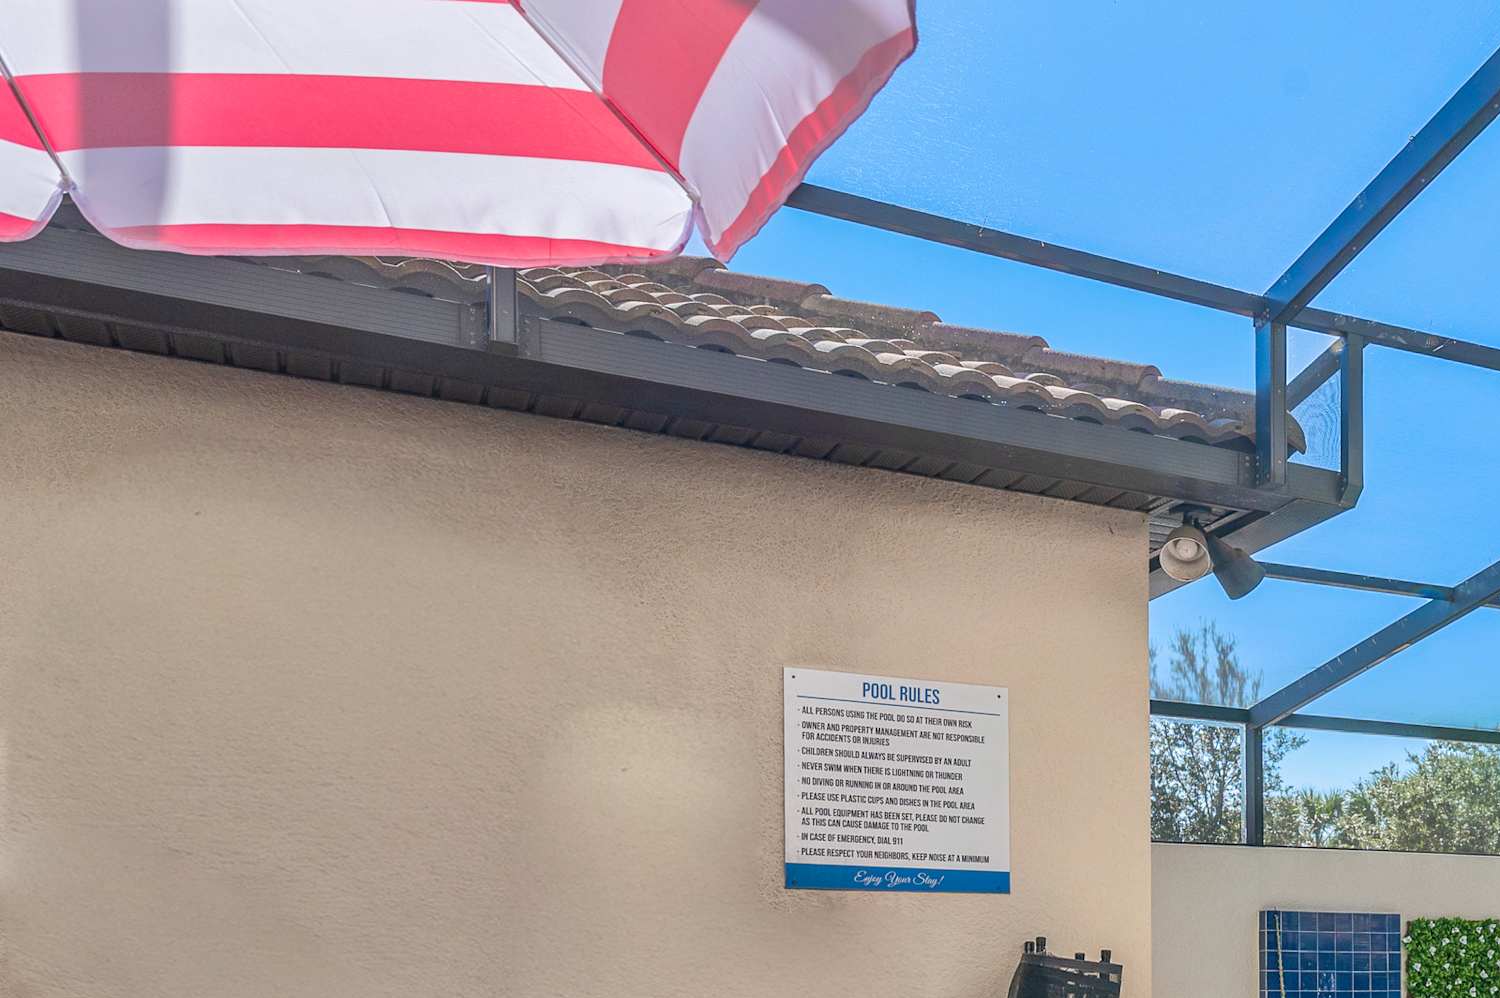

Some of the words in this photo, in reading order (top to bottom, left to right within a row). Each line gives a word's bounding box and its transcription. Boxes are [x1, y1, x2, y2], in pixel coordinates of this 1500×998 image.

[862, 682, 896, 700] POOL
[900, 686, 940, 704] RULES
[802, 706, 813, 715] ALL
[815, 707, 845, 718] PERSONS
[846, 709, 865, 720] USING
[866, 711, 878, 721] THE
[879, 712, 894, 722] POOL
[896, 713, 905, 723] DO
[906, 714, 914, 723] SO
[916, 715, 923, 724] AT
[925, 716, 942, 725] THEIR
[943, 717, 957, 727] OWN
[958, 718, 972, 728] RISK
[802, 721, 825, 731] OWNER
[827, 723, 840, 732] AND
[841, 724, 873, 735] PROPERTY
[875, 726, 917, 738] MANAGEMENT
[919, 730, 931, 739] ARE
[932, 731, 944, 740] NOT
[945, 732, 984, 743] RESPONSIBLE
[802, 731, 814, 741] FOR
[816, 732, 851, 743] ACCIDENTS
[852, 735, 861, 744] OR
[862, 736, 890, 746] INJURIES
[802, 746, 833, 757] CHILDREN
[835, 749, 860, 759] SHOULD
[861, 750, 886, 761] ALWAYS
[887, 752, 895, 761] BE
[896, 753, 933, 764] SUPERVISED
[934, 755, 942, 765] BY
[944, 756, 952, 765] AN
[953, 757, 971, 766] ADULT
[802, 761, 822, 772] NEVER
[824, 763, 842, 773] SWIM
[843, 764, 862, 774] WHEN
[864, 765, 883, 775] THERE
[885, 767, 891, 776] IS
[892, 767, 924, 778] LIGHTNING
[925, 769, 934, 778] OR
[935, 770, 962, 780] THUNDER
[802, 776, 811, 786] NO
[812, 777, 834, 787] DIVING
[835, 778, 844, 788] OR
[845, 779, 873, 789] RUNNING
[874, 781, 881, 790] IN
[882, 781, 891, 790] OR
[892, 782, 917, 792] AROUND
[919, 783, 930, 792] THE
[931, 784, 945, 793] POOL
[948, 785, 963, 794] AREA
[802, 791, 825, 802] PLEASE
[827, 793, 839, 802] USE
[841, 794, 866, 804] PLASTIC
[867, 795, 884, 805] CUPS
[885, 796, 898, 805] AND
[899, 797, 921, 807] DISHES
[922, 798, 929, 807] IN
[930, 798, 941, 808] THE
[943, 799, 957, 808] POOL
[960, 800, 975, 809] AREA
[802, 807, 813, 816] ALL
[815, 807, 831, 817] POOL
[833, 808, 868, 819] EQUIPMENT
[870, 810, 883, 819] HAS
[884, 811, 900, 820] BEEN
[901, 812, 913, 822] SET,
[915, 812, 937, 822] PLEASE
[939, 813, 947, 822] DO
[948, 814, 960, 823] NOT
[961, 814, 984, 824] CHANGE
[802, 817, 810, 827] AS
[812, 818, 826, 827] THIS
[828, 818, 841, 828] CAN
[842, 819, 862, 829] CAUSE
[863, 820, 889, 830] DAMAGE
[891, 821, 899, 830] TO
[901, 822, 912, 831] THE
[913, 822, 928, 832] POOL
[802, 832, 808, 841] IN
[809, 833, 826, 842] CASE
[827, 833, 835, 842] OF
[837, 834, 875, 845] EMERGENCY,
[877, 835, 890, 845] DIAL
[892, 836, 903, 845] 911
[802, 847, 825, 857] PLEASE
[826, 848, 854, 858] RESPECT
[856, 849, 873, 859] YOUR
[874, 850, 910, 861] NEIGHBORS,
[912, 851, 927, 861] KEEP
[929, 852, 946, 861] NOISE
[948, 853, 955, 861] AT
[956, 853, 960, 862] A
[961, 853, 989, 863] MINIMUM
[854, 870, 882, 886] Enjoy
[885, 871, 911, 887] Your
[913, 872, 944, 888] Stay!
